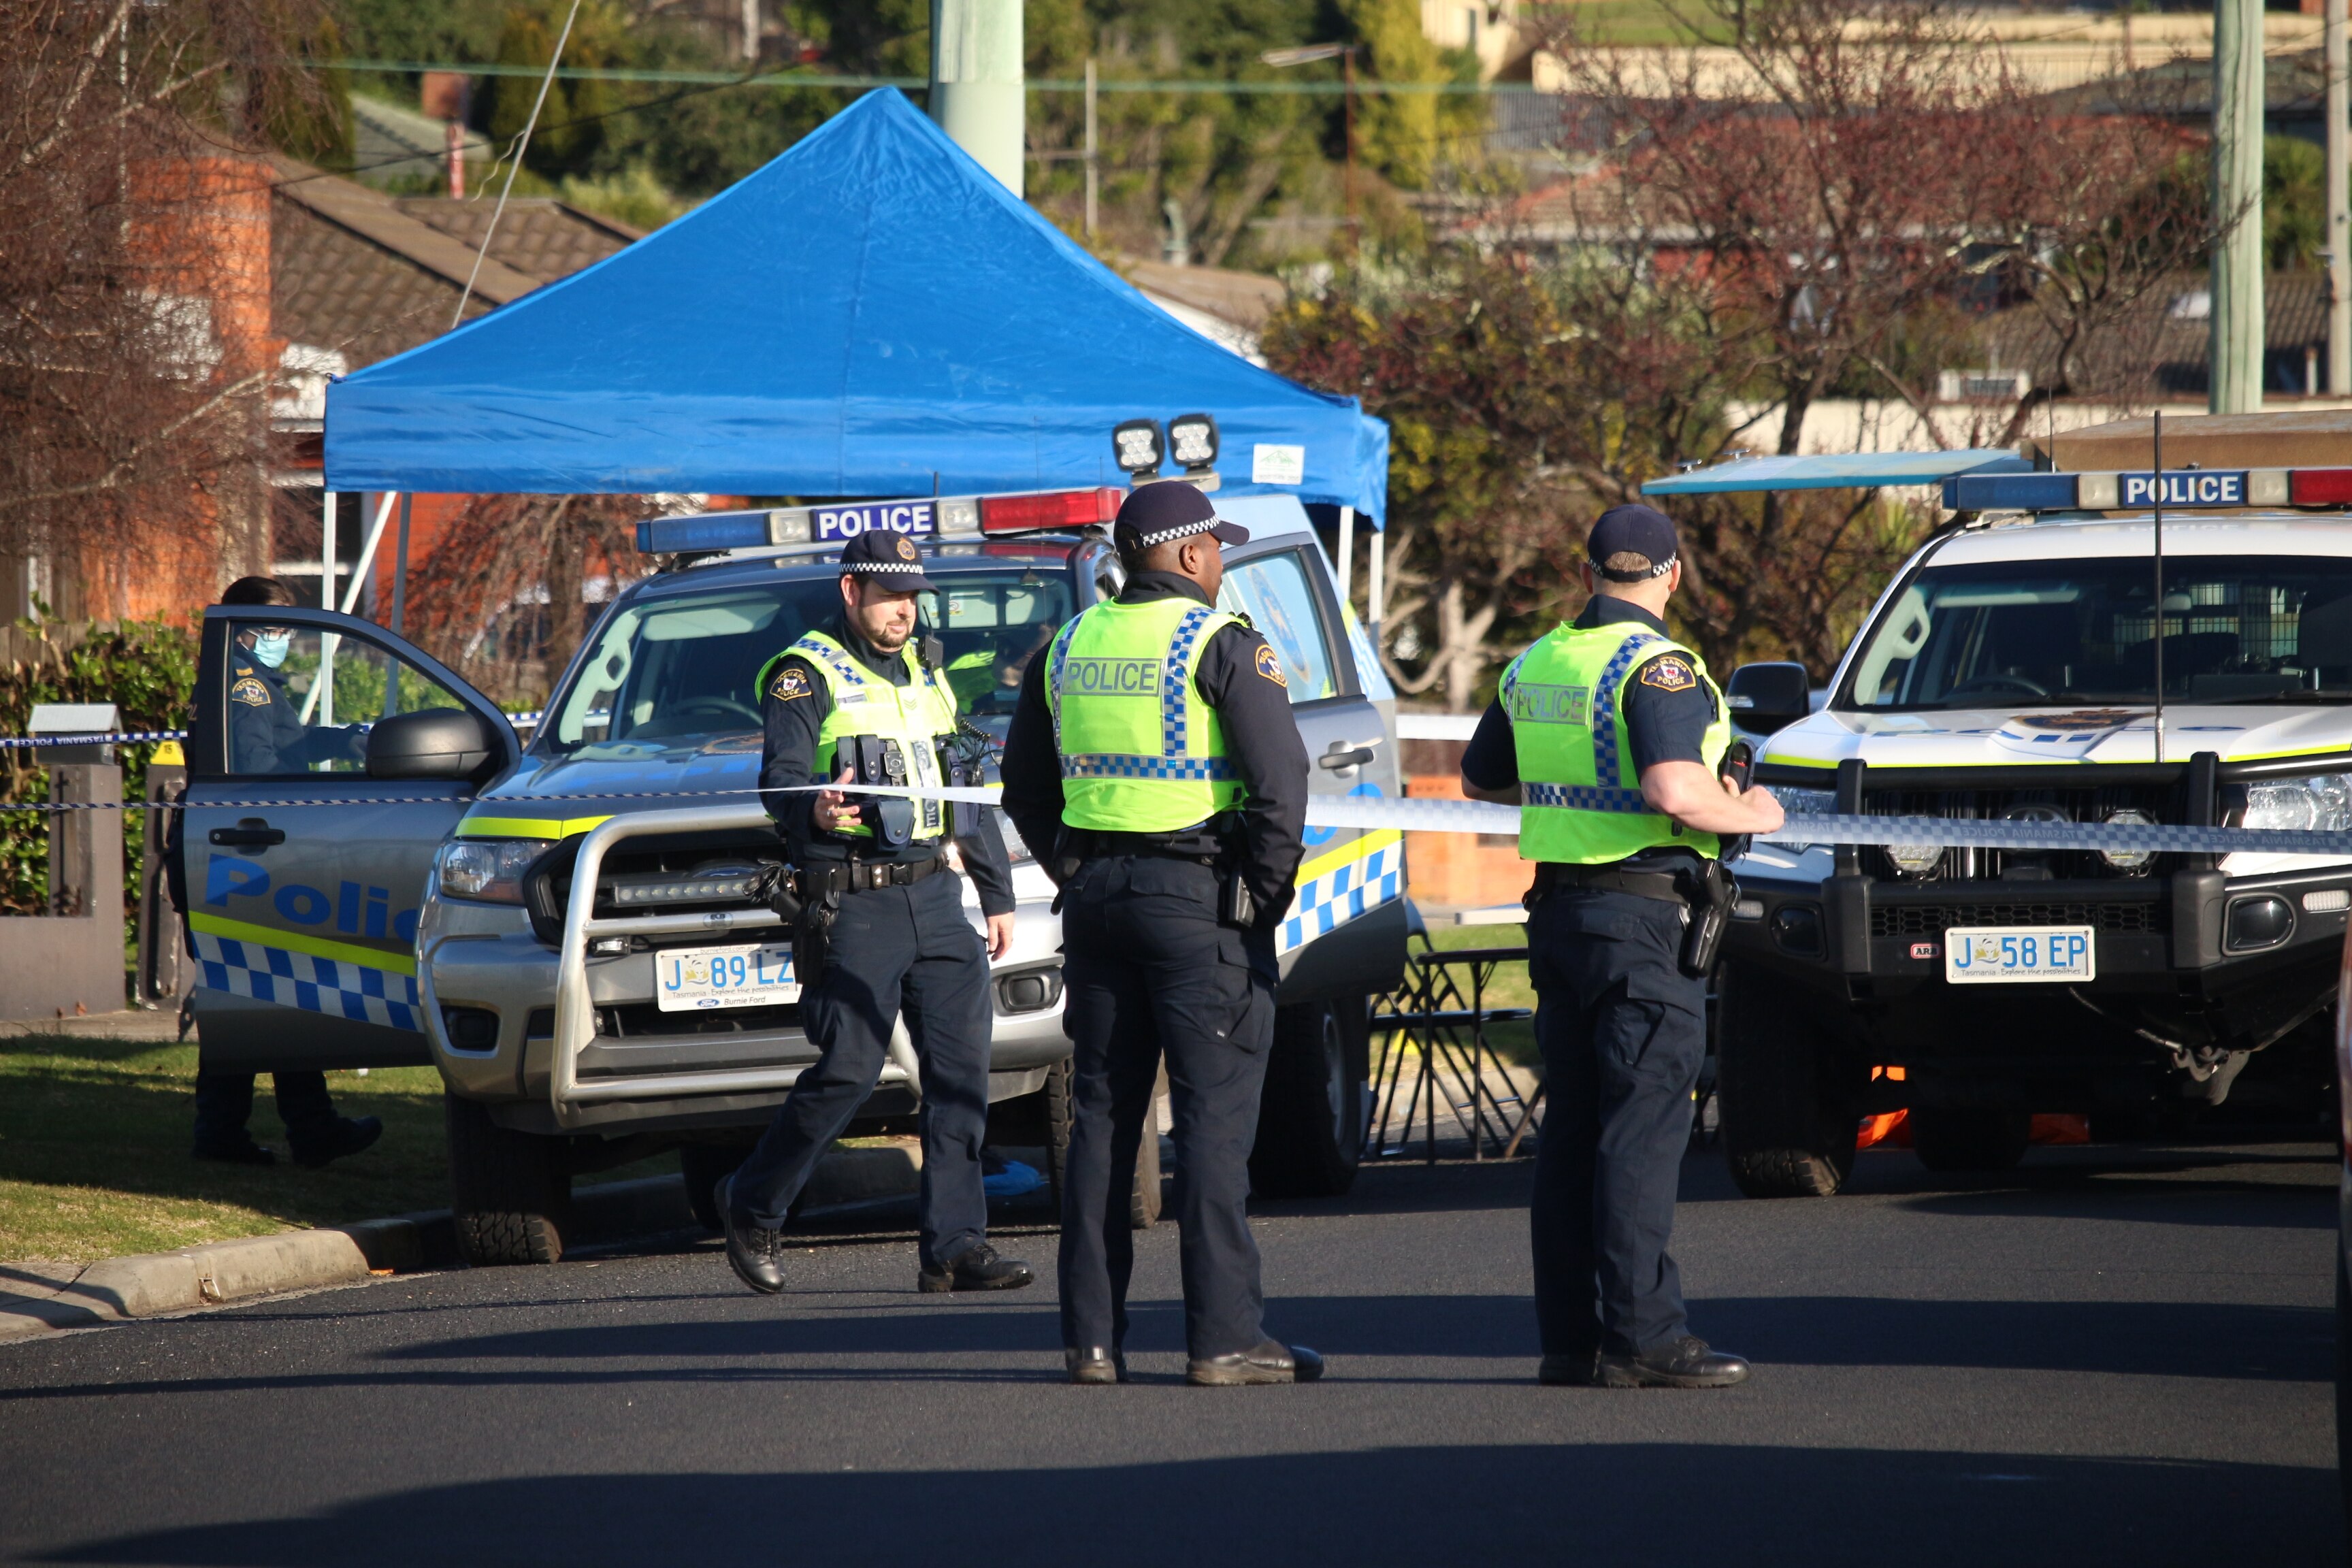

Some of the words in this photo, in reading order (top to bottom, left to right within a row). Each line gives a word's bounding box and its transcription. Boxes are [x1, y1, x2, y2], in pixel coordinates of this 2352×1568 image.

[2127, 476, 2240, 504] POLICE
[819, 506, 932, 539] POLICE
[1068, 662, 1156, 691] POLICE
[1648, 659, 1687, 674] TASMANIA
[777, 687, 800, 696] POLICE
[1656, 676, 1685, 686] POLICE
[242, 694, 263, 702] POLICE
[1516, 688, 1586, 719] POLICE
[20, 737, 53, 747] POLICE
[206, 853, 418, 944] Poli
[700, 945, 755, 954] burnieford.com.au
[1955, 937, 1972, 968] J
[2002, 937, 2038, 968] 58
[2048, 936, 2086, 967] EP
[665, 960, 681, 991] J
[710, 956, 746, 988] 89
[757, 951, 794, 985] LZ
[711, 988, 735, 996] Explore
[751, 985, 789, 994] possibilities
